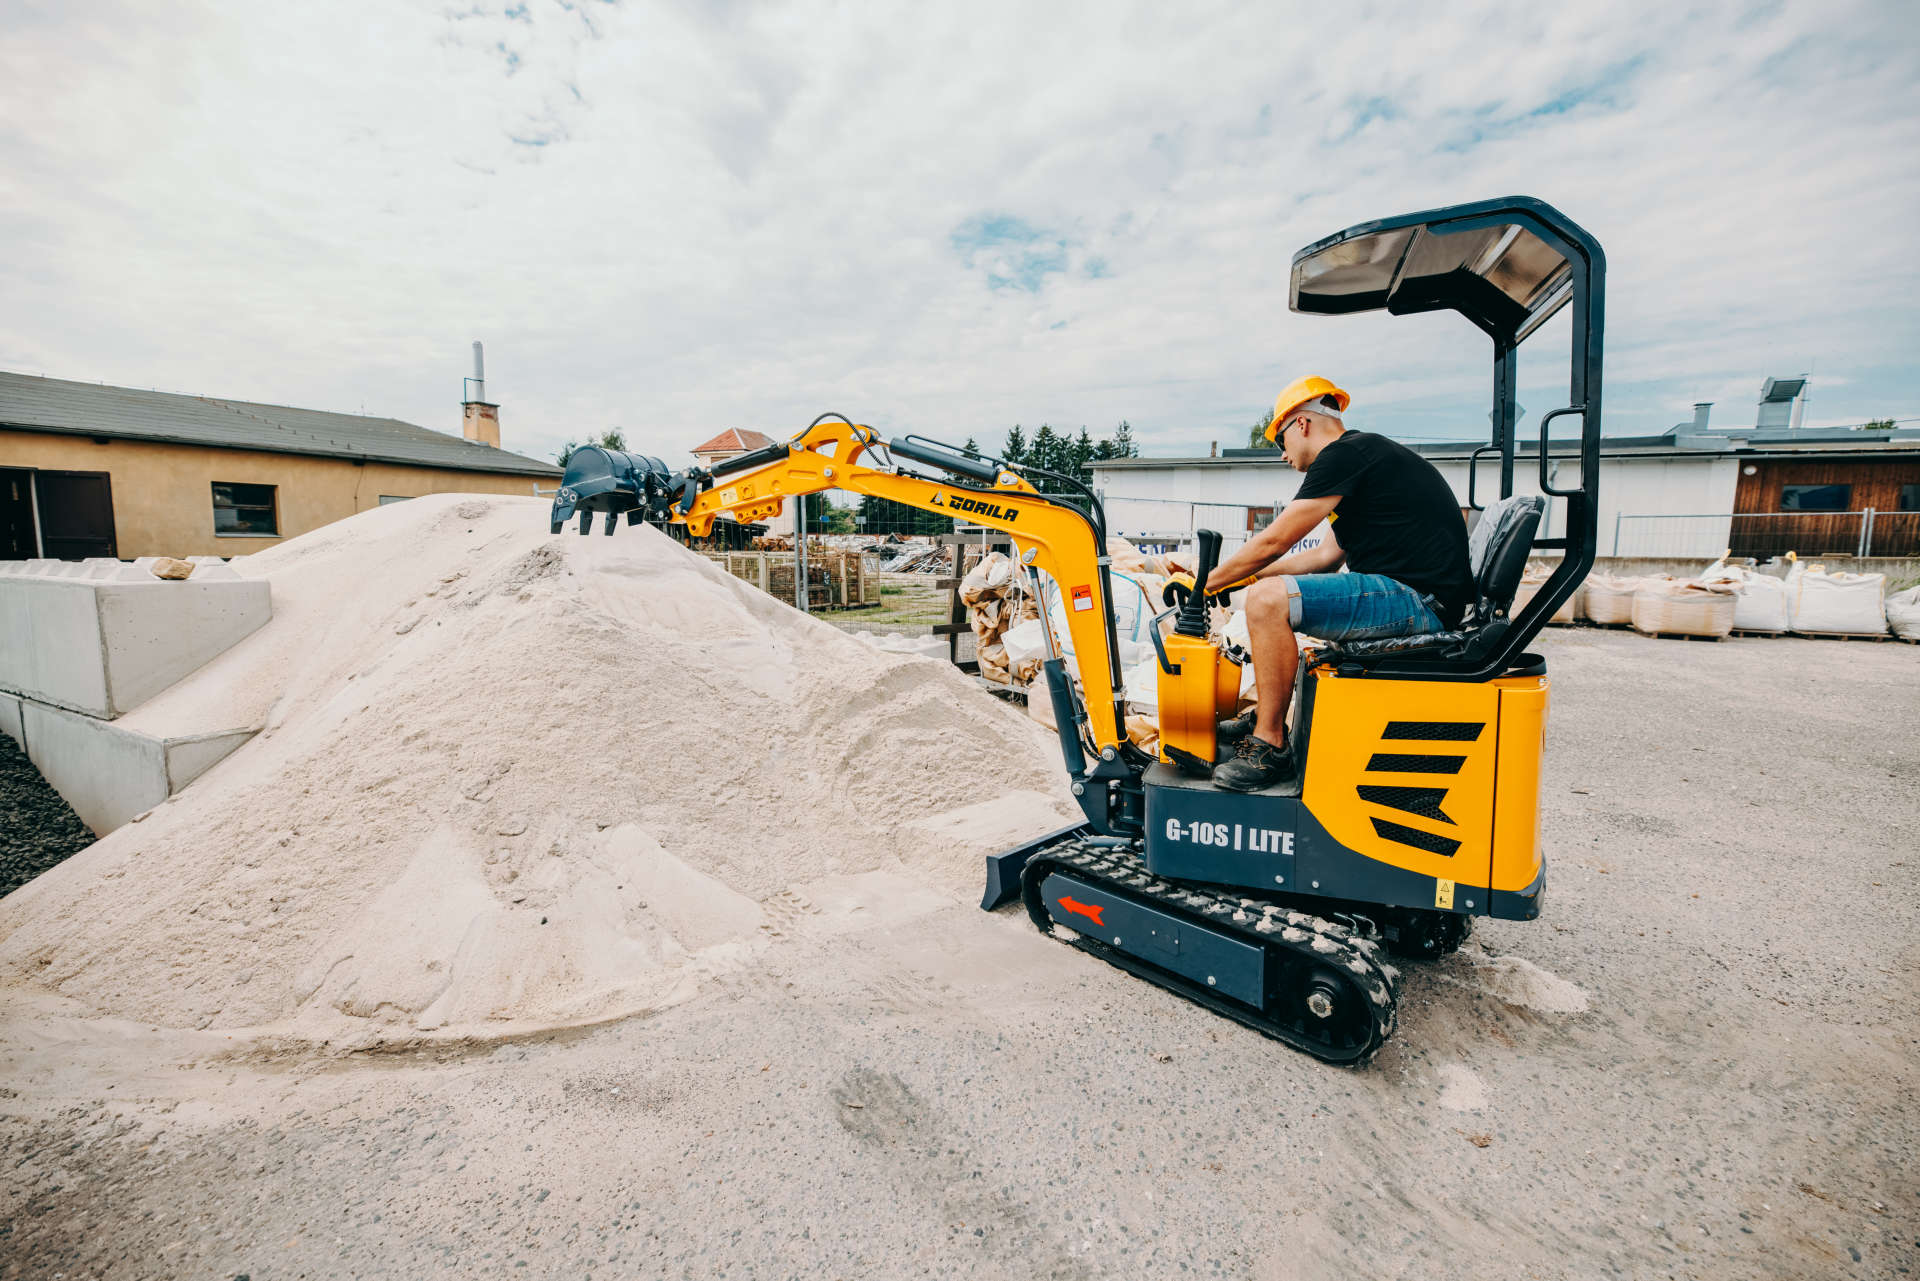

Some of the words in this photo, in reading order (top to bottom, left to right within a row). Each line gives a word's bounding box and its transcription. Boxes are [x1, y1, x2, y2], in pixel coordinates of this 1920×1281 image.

[949, 495, 1019, 522] GORILA
[1166, 818, 1229, 847] G-10S
[1249, 828, 1295, 855] LITE
